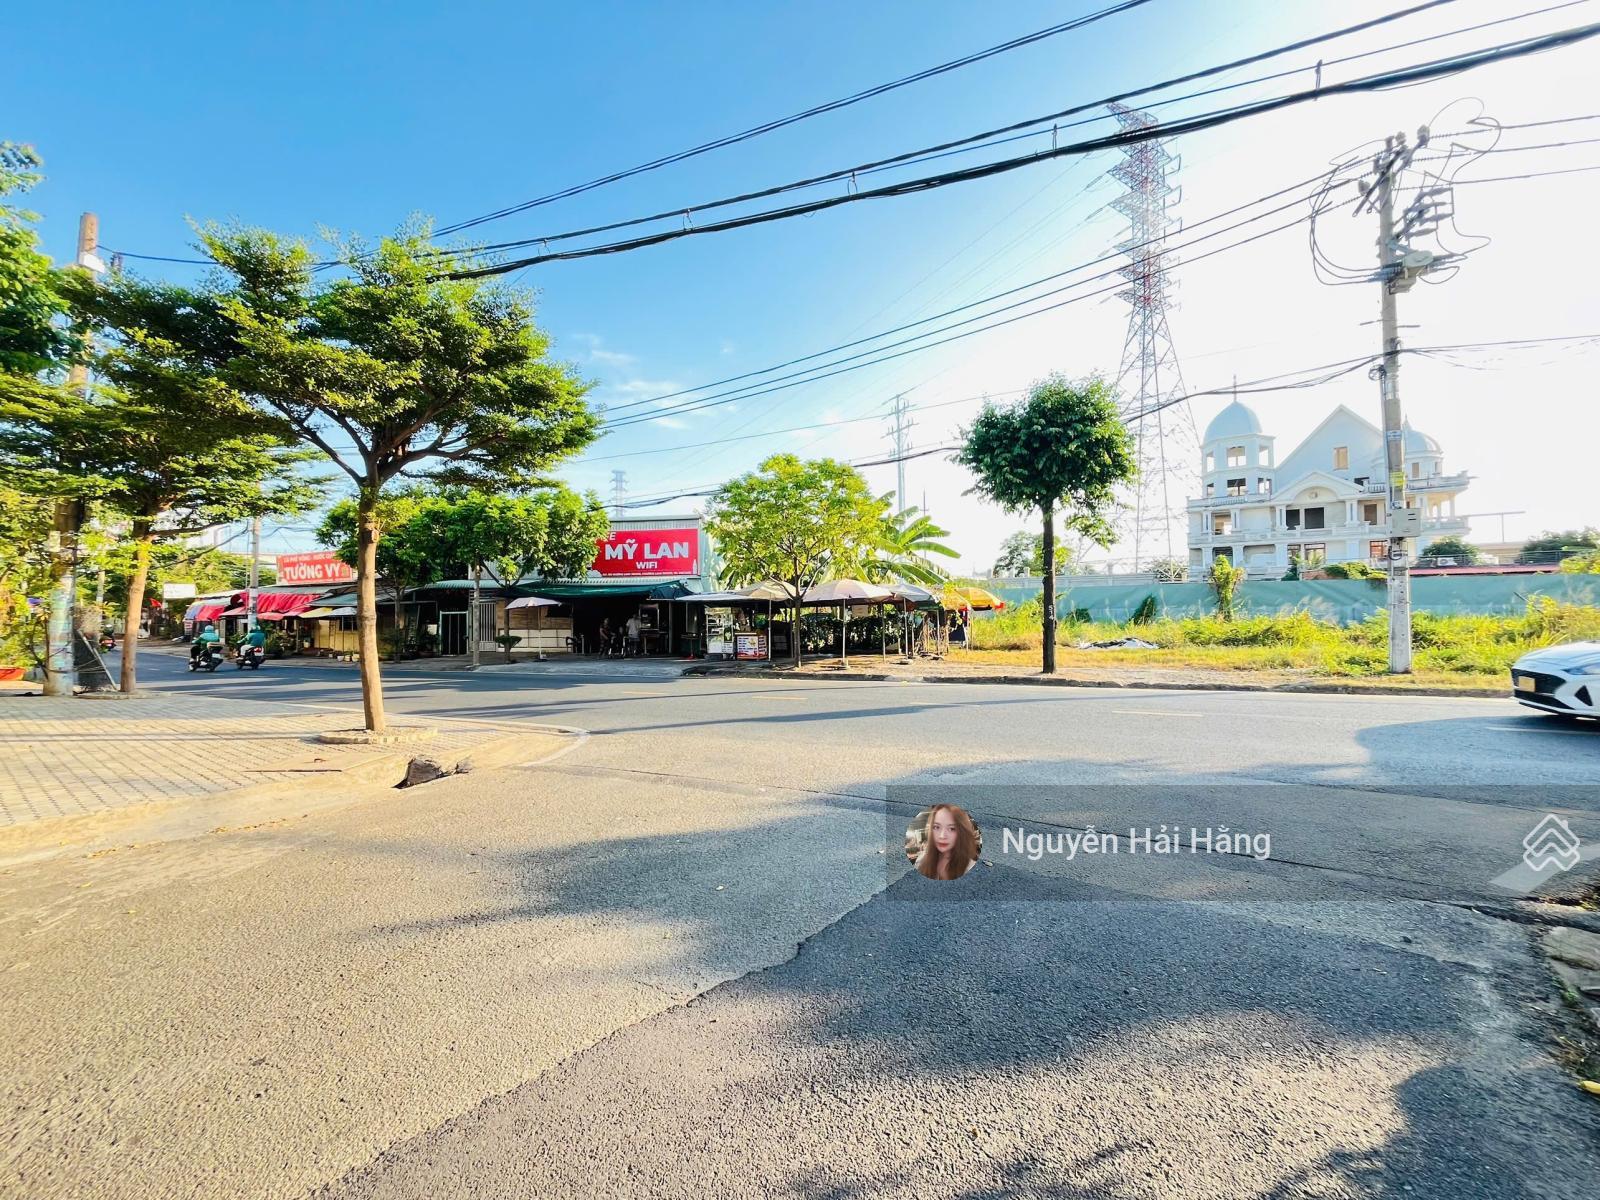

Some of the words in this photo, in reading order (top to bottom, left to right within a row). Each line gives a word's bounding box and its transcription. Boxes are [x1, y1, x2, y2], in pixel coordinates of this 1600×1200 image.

[605, 538, 638, 560] MỸ
[644, 541, 689, 559] LAN
[325, 563, 340, 577] VY
[636, 561, 658, 569] WIFI
